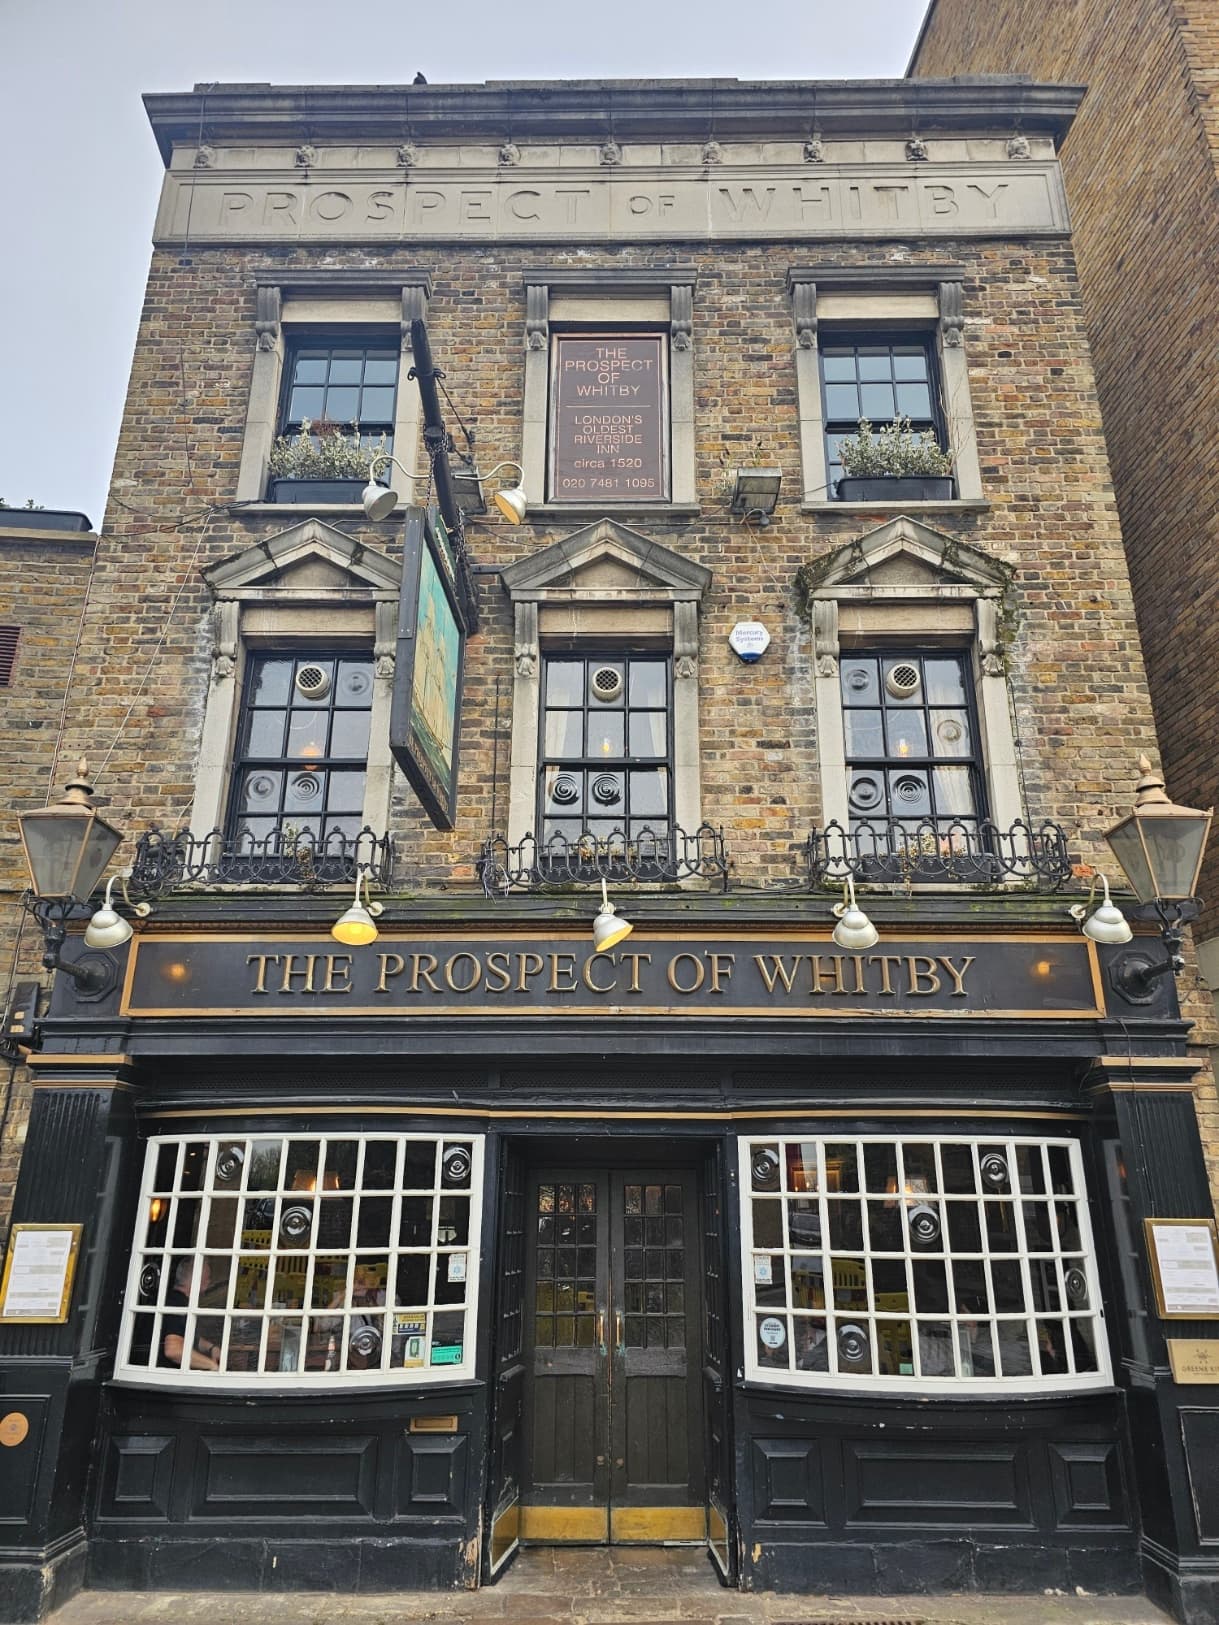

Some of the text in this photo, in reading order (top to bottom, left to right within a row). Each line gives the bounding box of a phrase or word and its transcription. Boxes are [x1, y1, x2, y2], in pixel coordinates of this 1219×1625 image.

[217, 183, 1009, 226] PROSPECT OF WHITBY
[596, 347, 628, 359] THE
[565, 359, 653, 372] PROSPECT
[597, 372, 621, 384] OF
[576, 384, 641, 397] WHITBY
[574, 415, 643, 425] LONDON'S
[582, 424, 633, 435] OLDEST
[574, 434, 643, 444] RIVERSIDE
[597, 444, 620, 454] INN
[574, 458, 642, 469] circa 1520
[562, 478, 586, 489] 020
[590, 478, 619, 488] 7481
[246, 952, 977, 997] THE PROSPECT OF WHITBY
